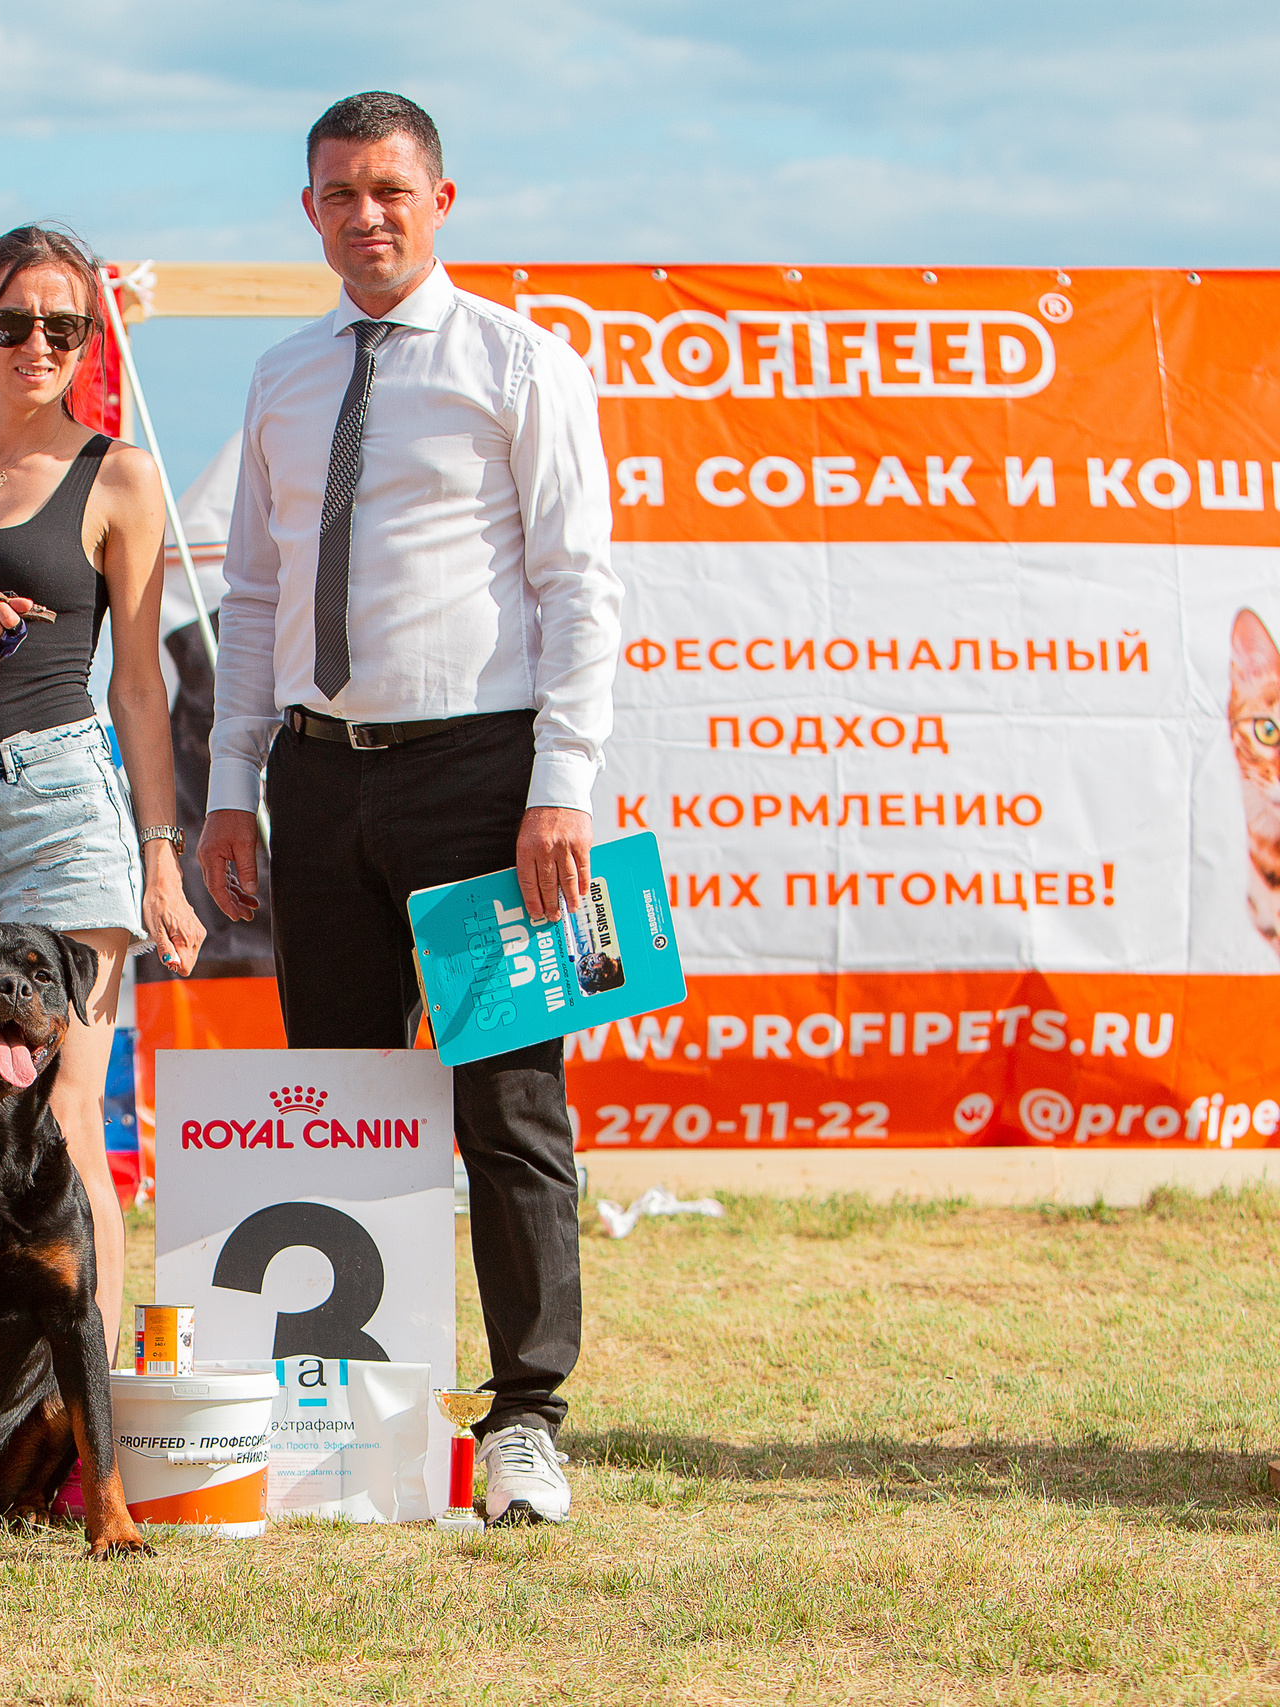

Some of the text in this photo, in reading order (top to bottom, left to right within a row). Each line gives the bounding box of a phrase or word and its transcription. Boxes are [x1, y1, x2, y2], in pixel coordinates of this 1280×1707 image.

[695, 455, 976, 507] СОБАК
[1005, 456, 1056, 506] И
[1086, 457, 1280, 512] КОШ
[624, 630, 1150, 672] ФЕССИОНАЛЬНЫЙ
[708, 714, 949, 755] ПОДХОД
[616, 794, 1044, 828] К КОРМЛЕНИЮ
[785, 862, 1116, 911] ПИТОМЦЕВ!
[589, 881, 611, 948] VII Silver CUP
[536, 930, 560, 984] Silver
[544, 986, 566, 1012] VII
[564, 1004, 1174, 1061] WW.PROFIPETS.RU
[182, 1119, 294, 1149] ROYAL
[595, 1101, 890, 1145] 270-11-22
[1020, 1088, 1280, 1149] @profipe
[212, 1201, 392, 1362] 3
[120, 1436, 186, 1449] PROFIFEED
[271, 1419, 355, 1433] астрафарм
[277, 1468, 352, 1477] www.astrafarm.com
